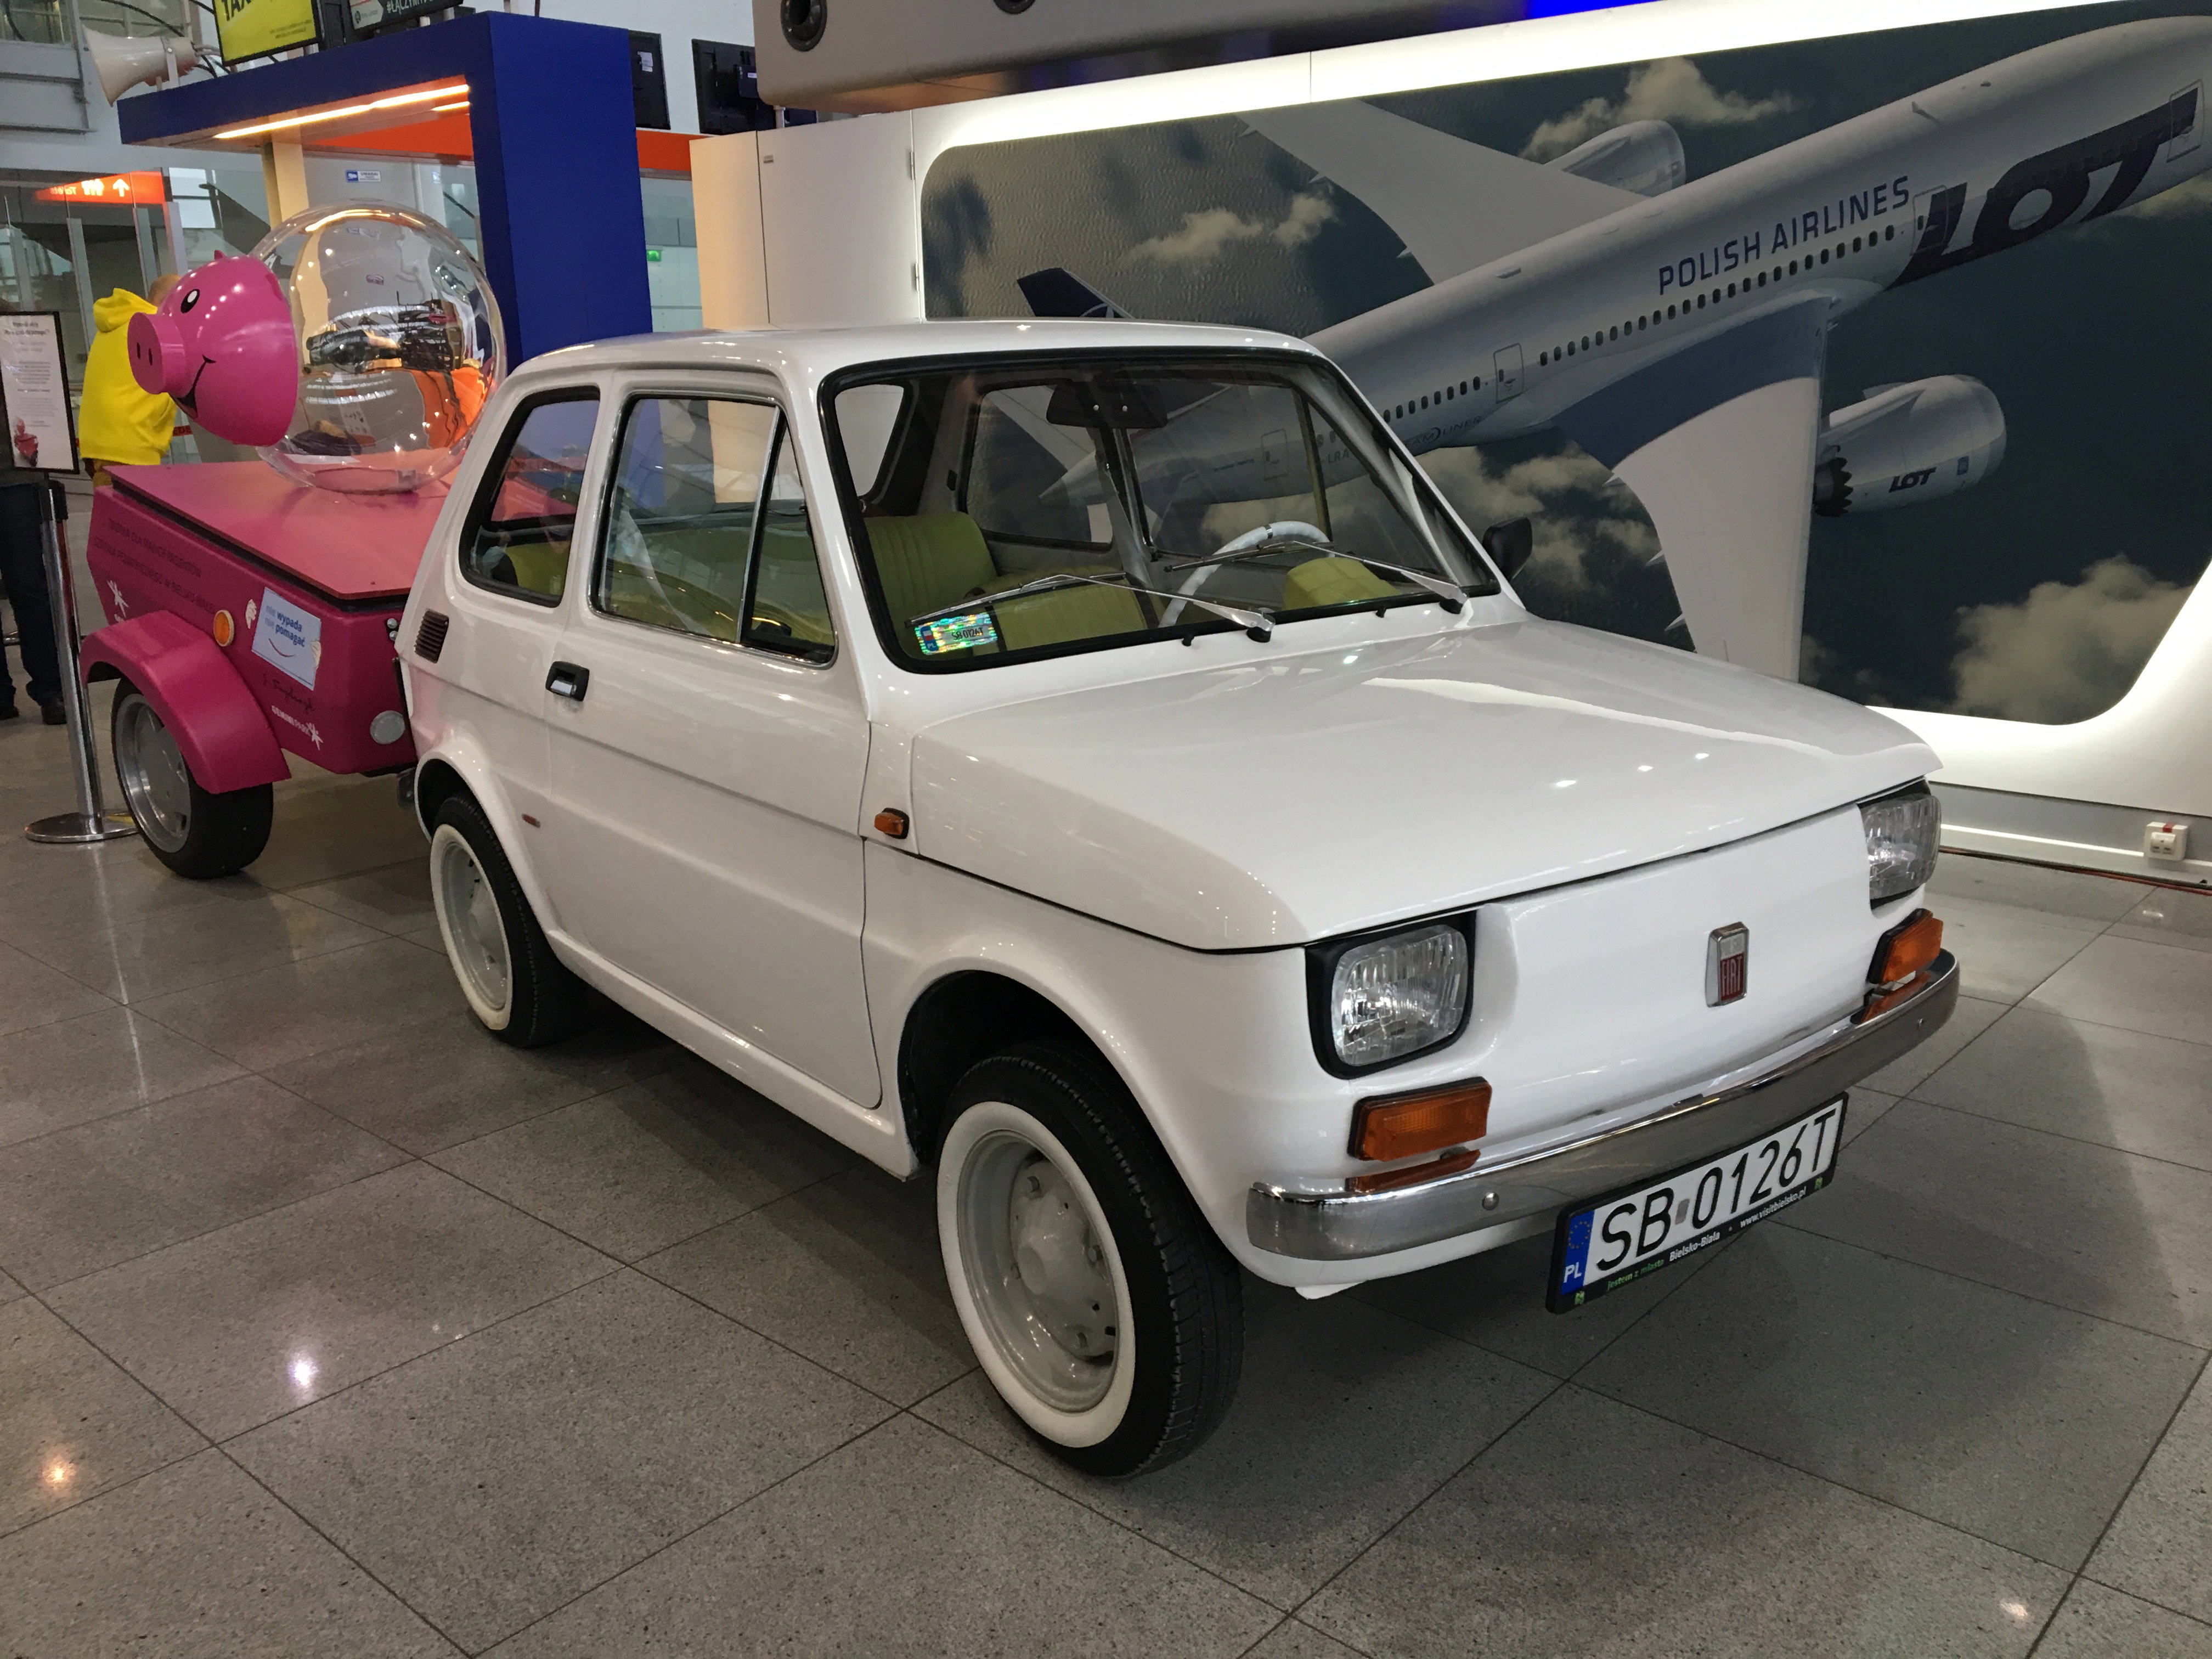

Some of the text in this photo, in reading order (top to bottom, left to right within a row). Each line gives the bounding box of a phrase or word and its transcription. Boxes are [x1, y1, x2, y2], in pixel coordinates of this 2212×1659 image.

[1883, 87, 2198, 292] LOT
[1659, 175, 1909, 295] POLISH AIRLINES
[1888, 466, 1937, 493] LOT
[275, 623, 306, 647] pomagać
[277, 610, 302, 633] wypada
[1722, 955, 1743, 997] FIAT
[1596, 1108, 1837, 1271] SB 0126T
[1607, 1273, 1633, 1290] jestem
[1640, 1259, 1665, 1275] miasta
[1740, 1186, 1807, 1228] www.visitbielsko.pl
[1564, 1262, 1582, 1283] PL
